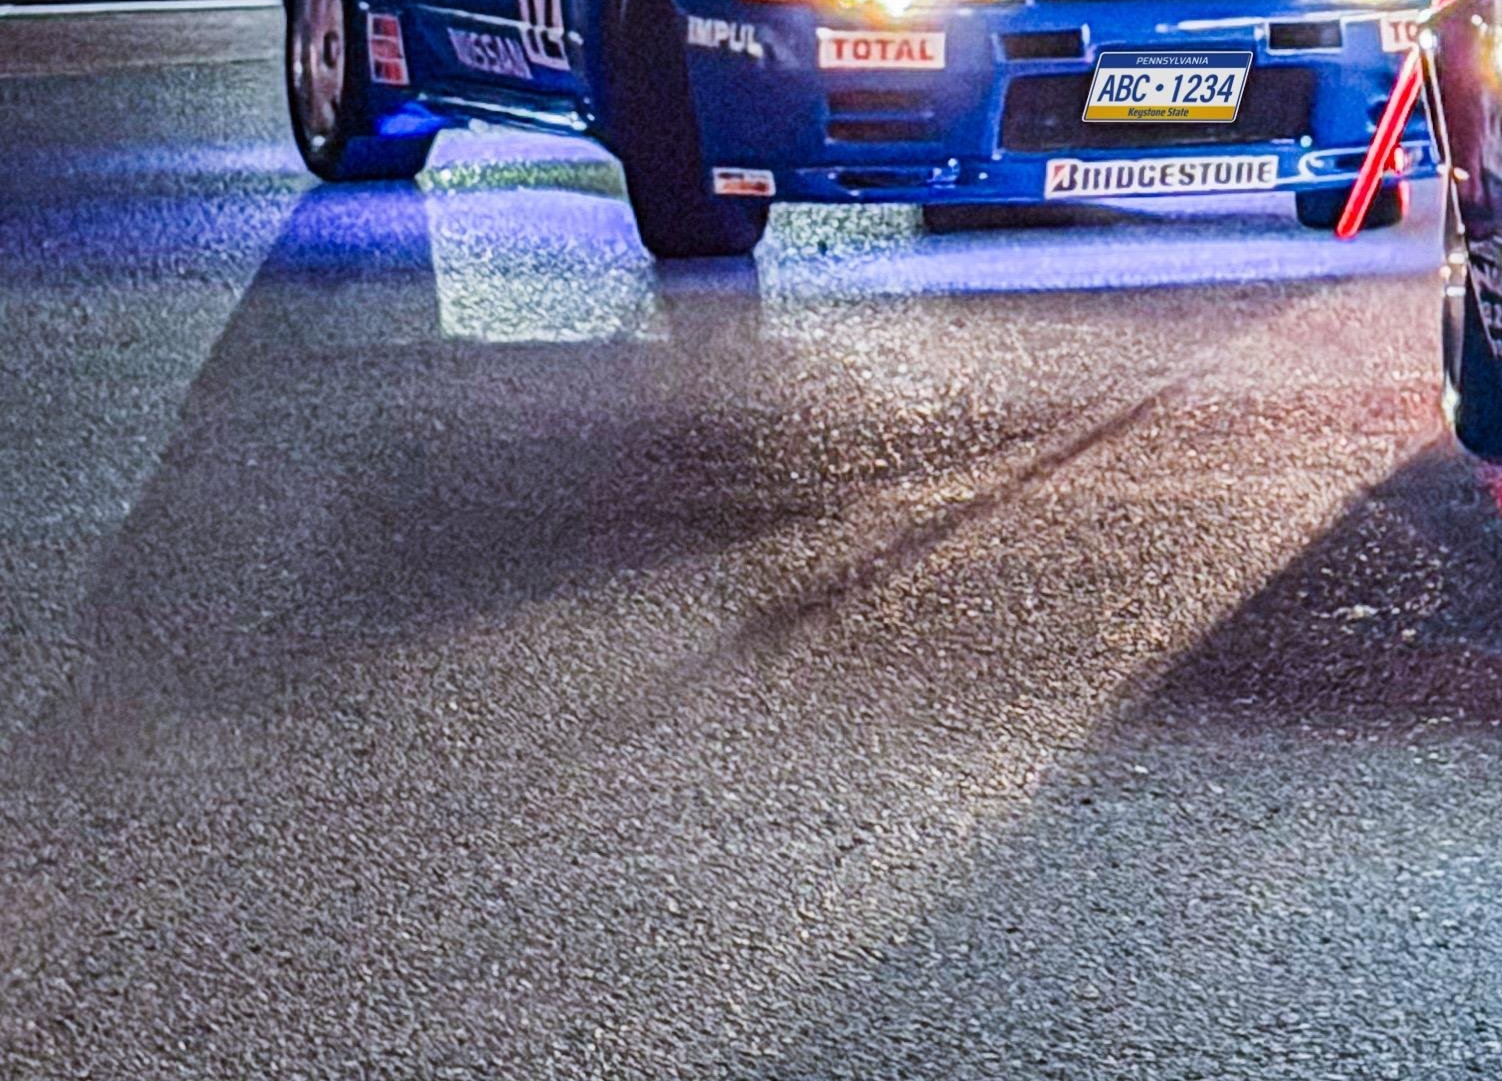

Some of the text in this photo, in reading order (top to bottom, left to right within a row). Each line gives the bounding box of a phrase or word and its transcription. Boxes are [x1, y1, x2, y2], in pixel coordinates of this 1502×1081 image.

[687, 15, 763, 58] IMPUL
[831, 38, 935, 61] TOTAL
[1136, 56, 1209, 65] PENNSYLVANIA
[1097, 74, 1235, 103] ABC 1234
[1127, 107, 1189, 118] Keystone State
[1051, 160, 1275, 194] BRIDGESTONE
